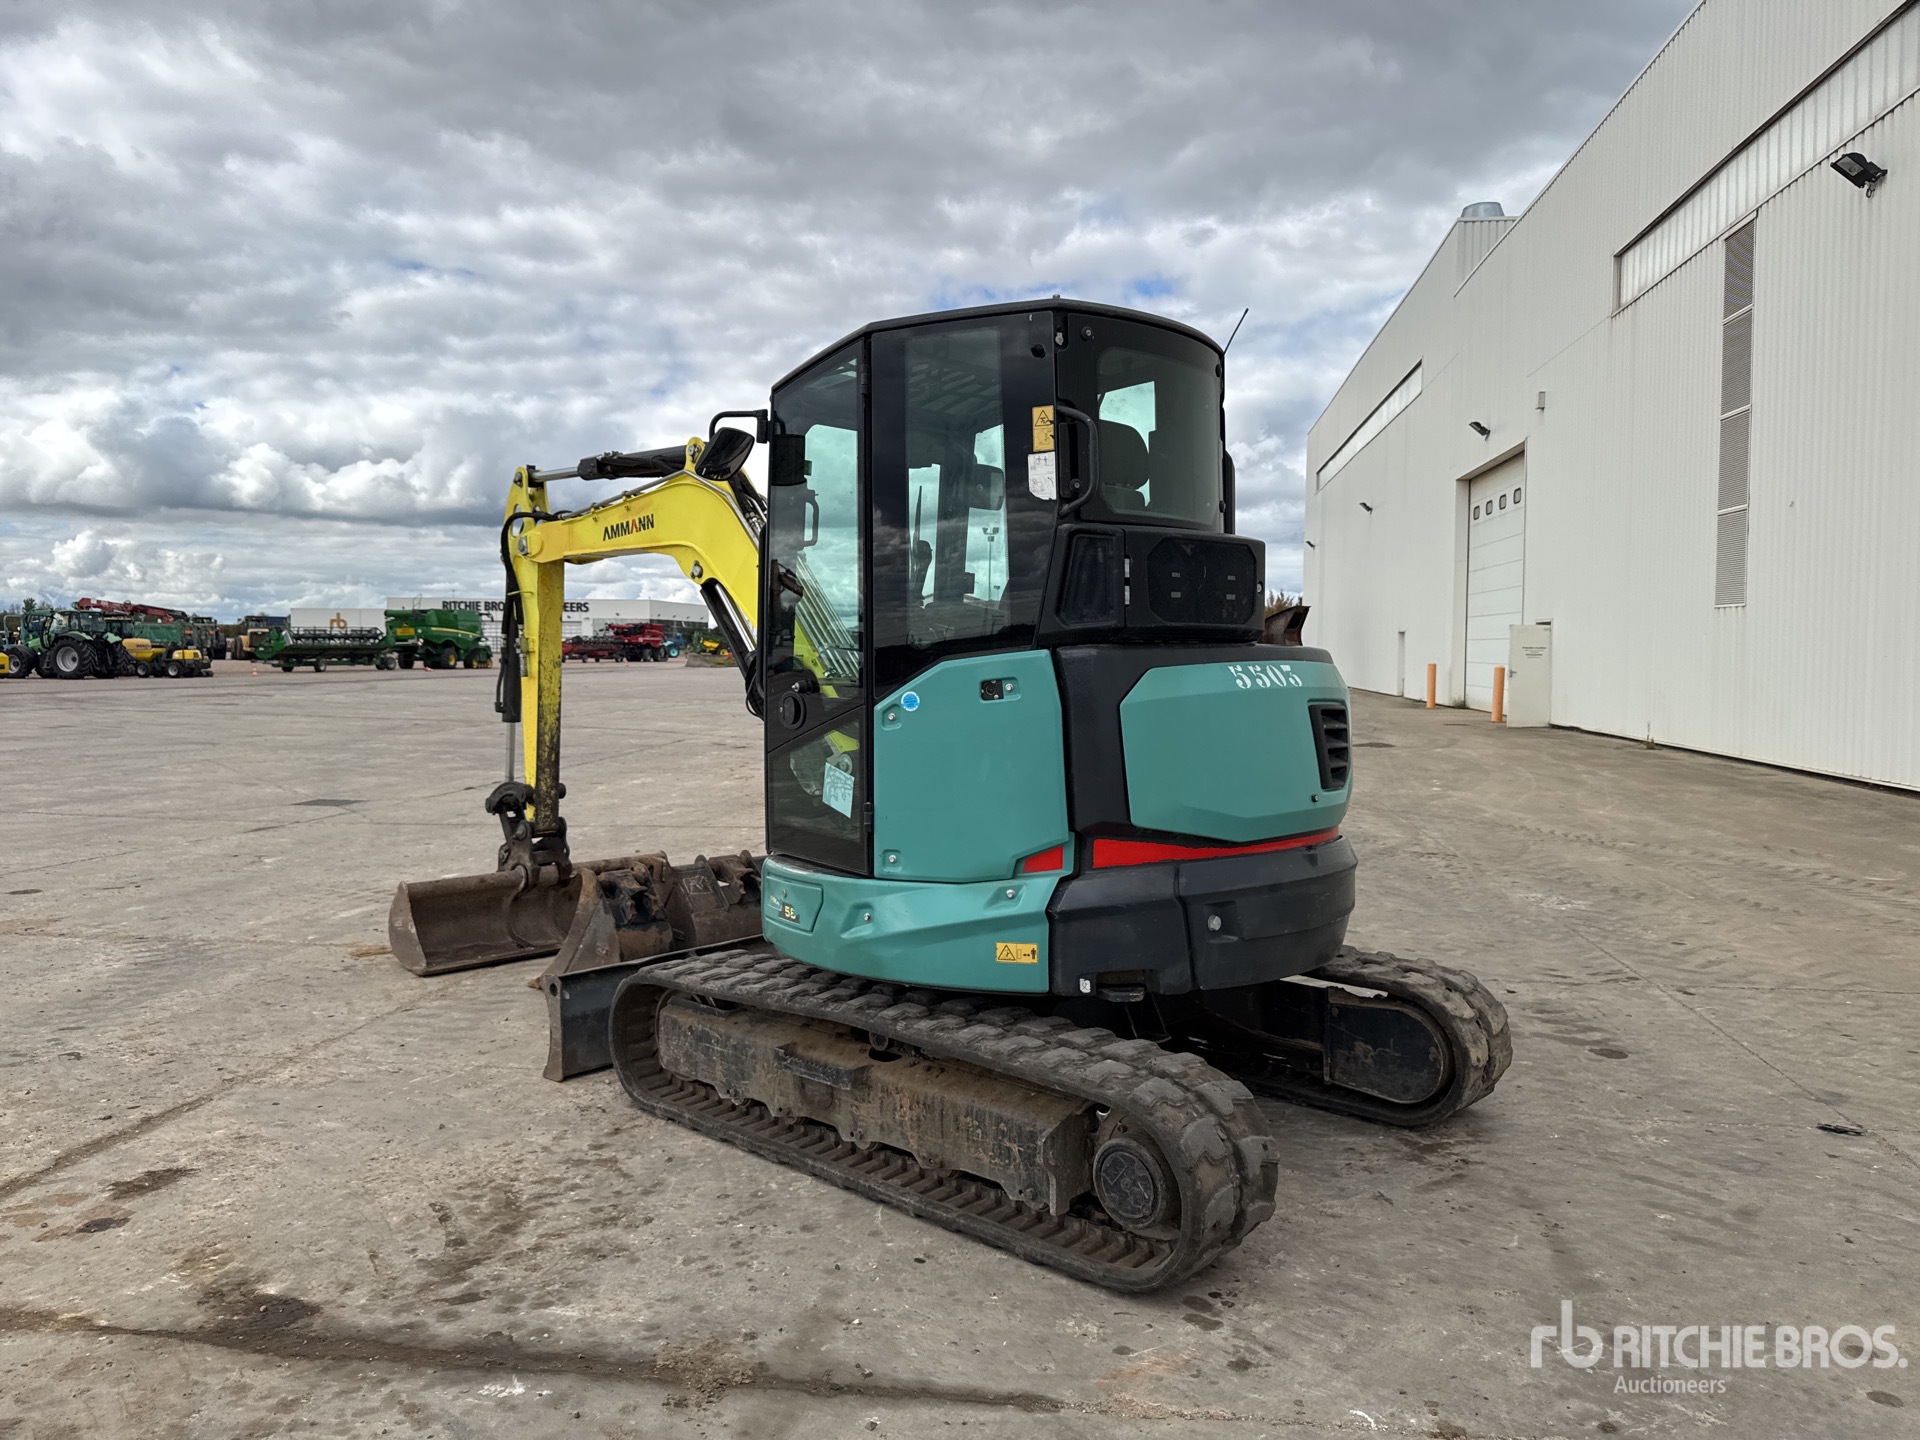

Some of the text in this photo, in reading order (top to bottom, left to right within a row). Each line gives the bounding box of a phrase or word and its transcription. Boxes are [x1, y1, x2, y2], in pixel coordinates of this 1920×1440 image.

[603, 513, 655, 541] AMMANN
[442, 601, 482, 611] RITCHIE
[484, 601, 504, 611] BRO
